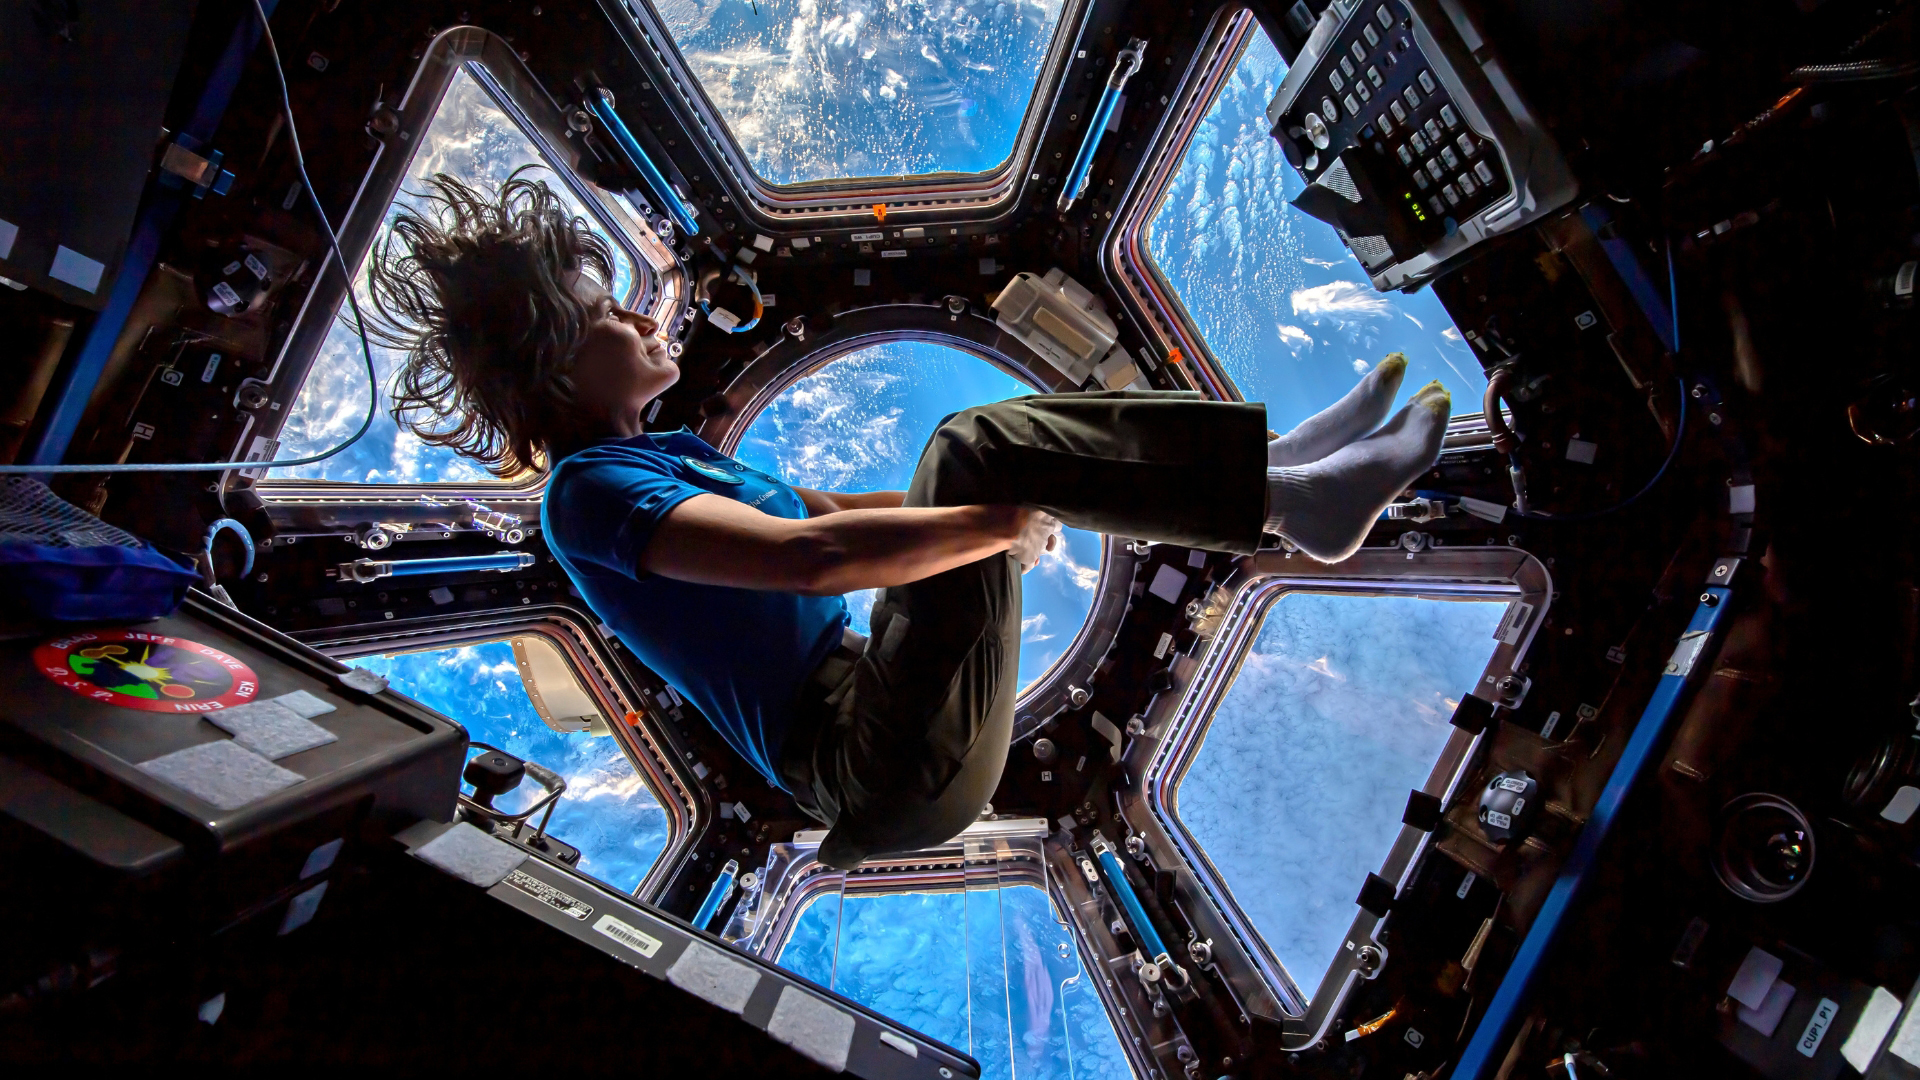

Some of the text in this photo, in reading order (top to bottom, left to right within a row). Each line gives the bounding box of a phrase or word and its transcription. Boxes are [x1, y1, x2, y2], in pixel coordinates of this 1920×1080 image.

[134, 424, 152, 439] H
[50, 632, 97, 649] BRAD
[124, 632, 175, 644] JEFF
[200, 648, 243, 670] DAVE
[237, 681, 254, 697] KEN
[174, 701, 224, 711] ERIN
[1803, 1005, 1832, 1049] CUP1_P1
